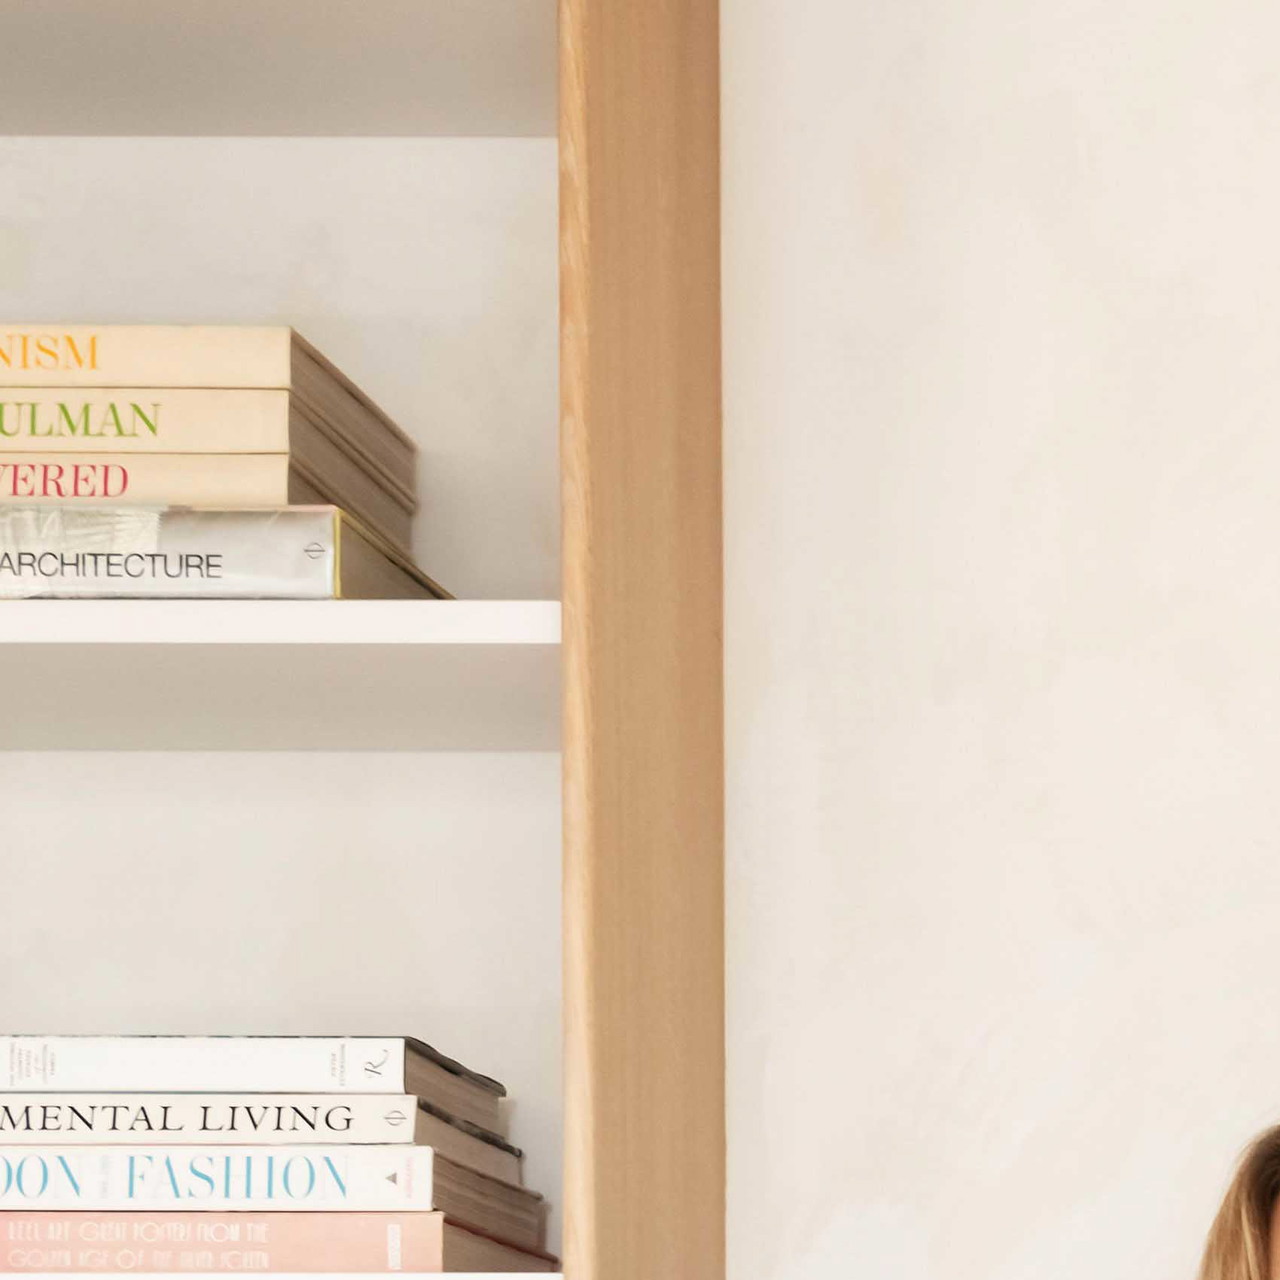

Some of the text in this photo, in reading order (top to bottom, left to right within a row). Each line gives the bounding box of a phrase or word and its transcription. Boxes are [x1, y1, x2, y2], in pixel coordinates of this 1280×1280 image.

[0, 551, 223, 578] ARCHITECTURE
[0, 1105, 353, 1132] MENTAL LIVING
[127, 1154, 349, 1199] FASHION
